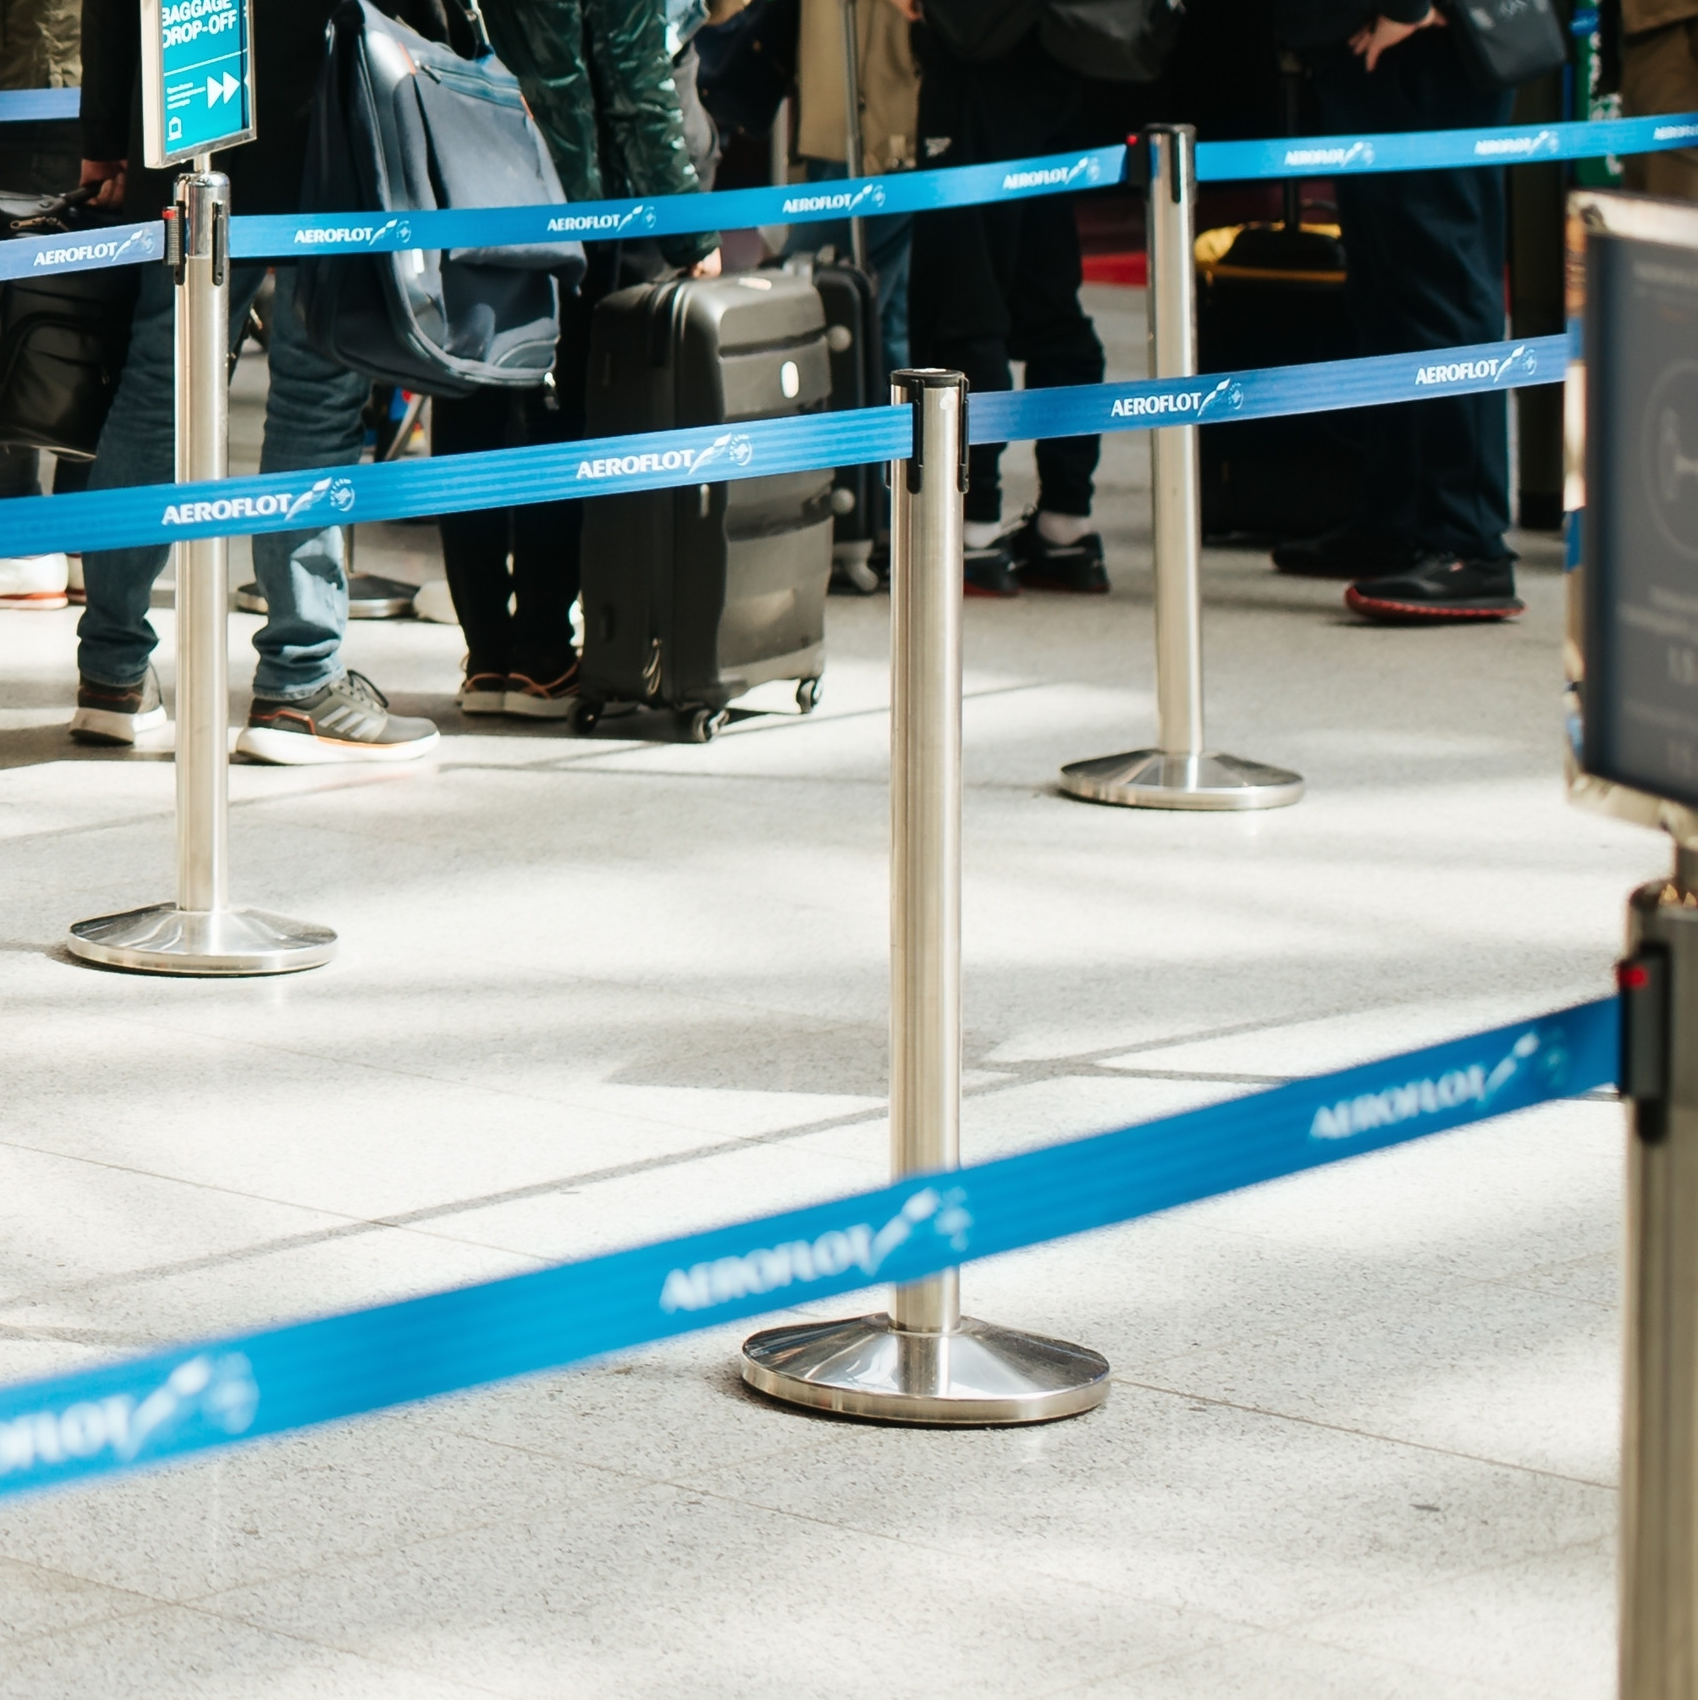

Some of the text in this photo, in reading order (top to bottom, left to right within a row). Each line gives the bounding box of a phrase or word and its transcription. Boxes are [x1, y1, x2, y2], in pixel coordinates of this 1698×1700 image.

[782, 193, 852, 214] AEROFLOT
[293, 226, 374, 244] AEROFLOT
[547, 215, 621, 232] AEROFLOT
[33, 241, 119, 268] AEROFLOT
[1415, 359, 1500, 386] AEROFLOT
[1111, 392, 1202, 418] AEROFLOT
[576, 449, 696, 480] AEROFLOT
[161, 493, 293, 526] AEROFLOT
[1307, 1063, 1488, 1143] AEROFLOT
